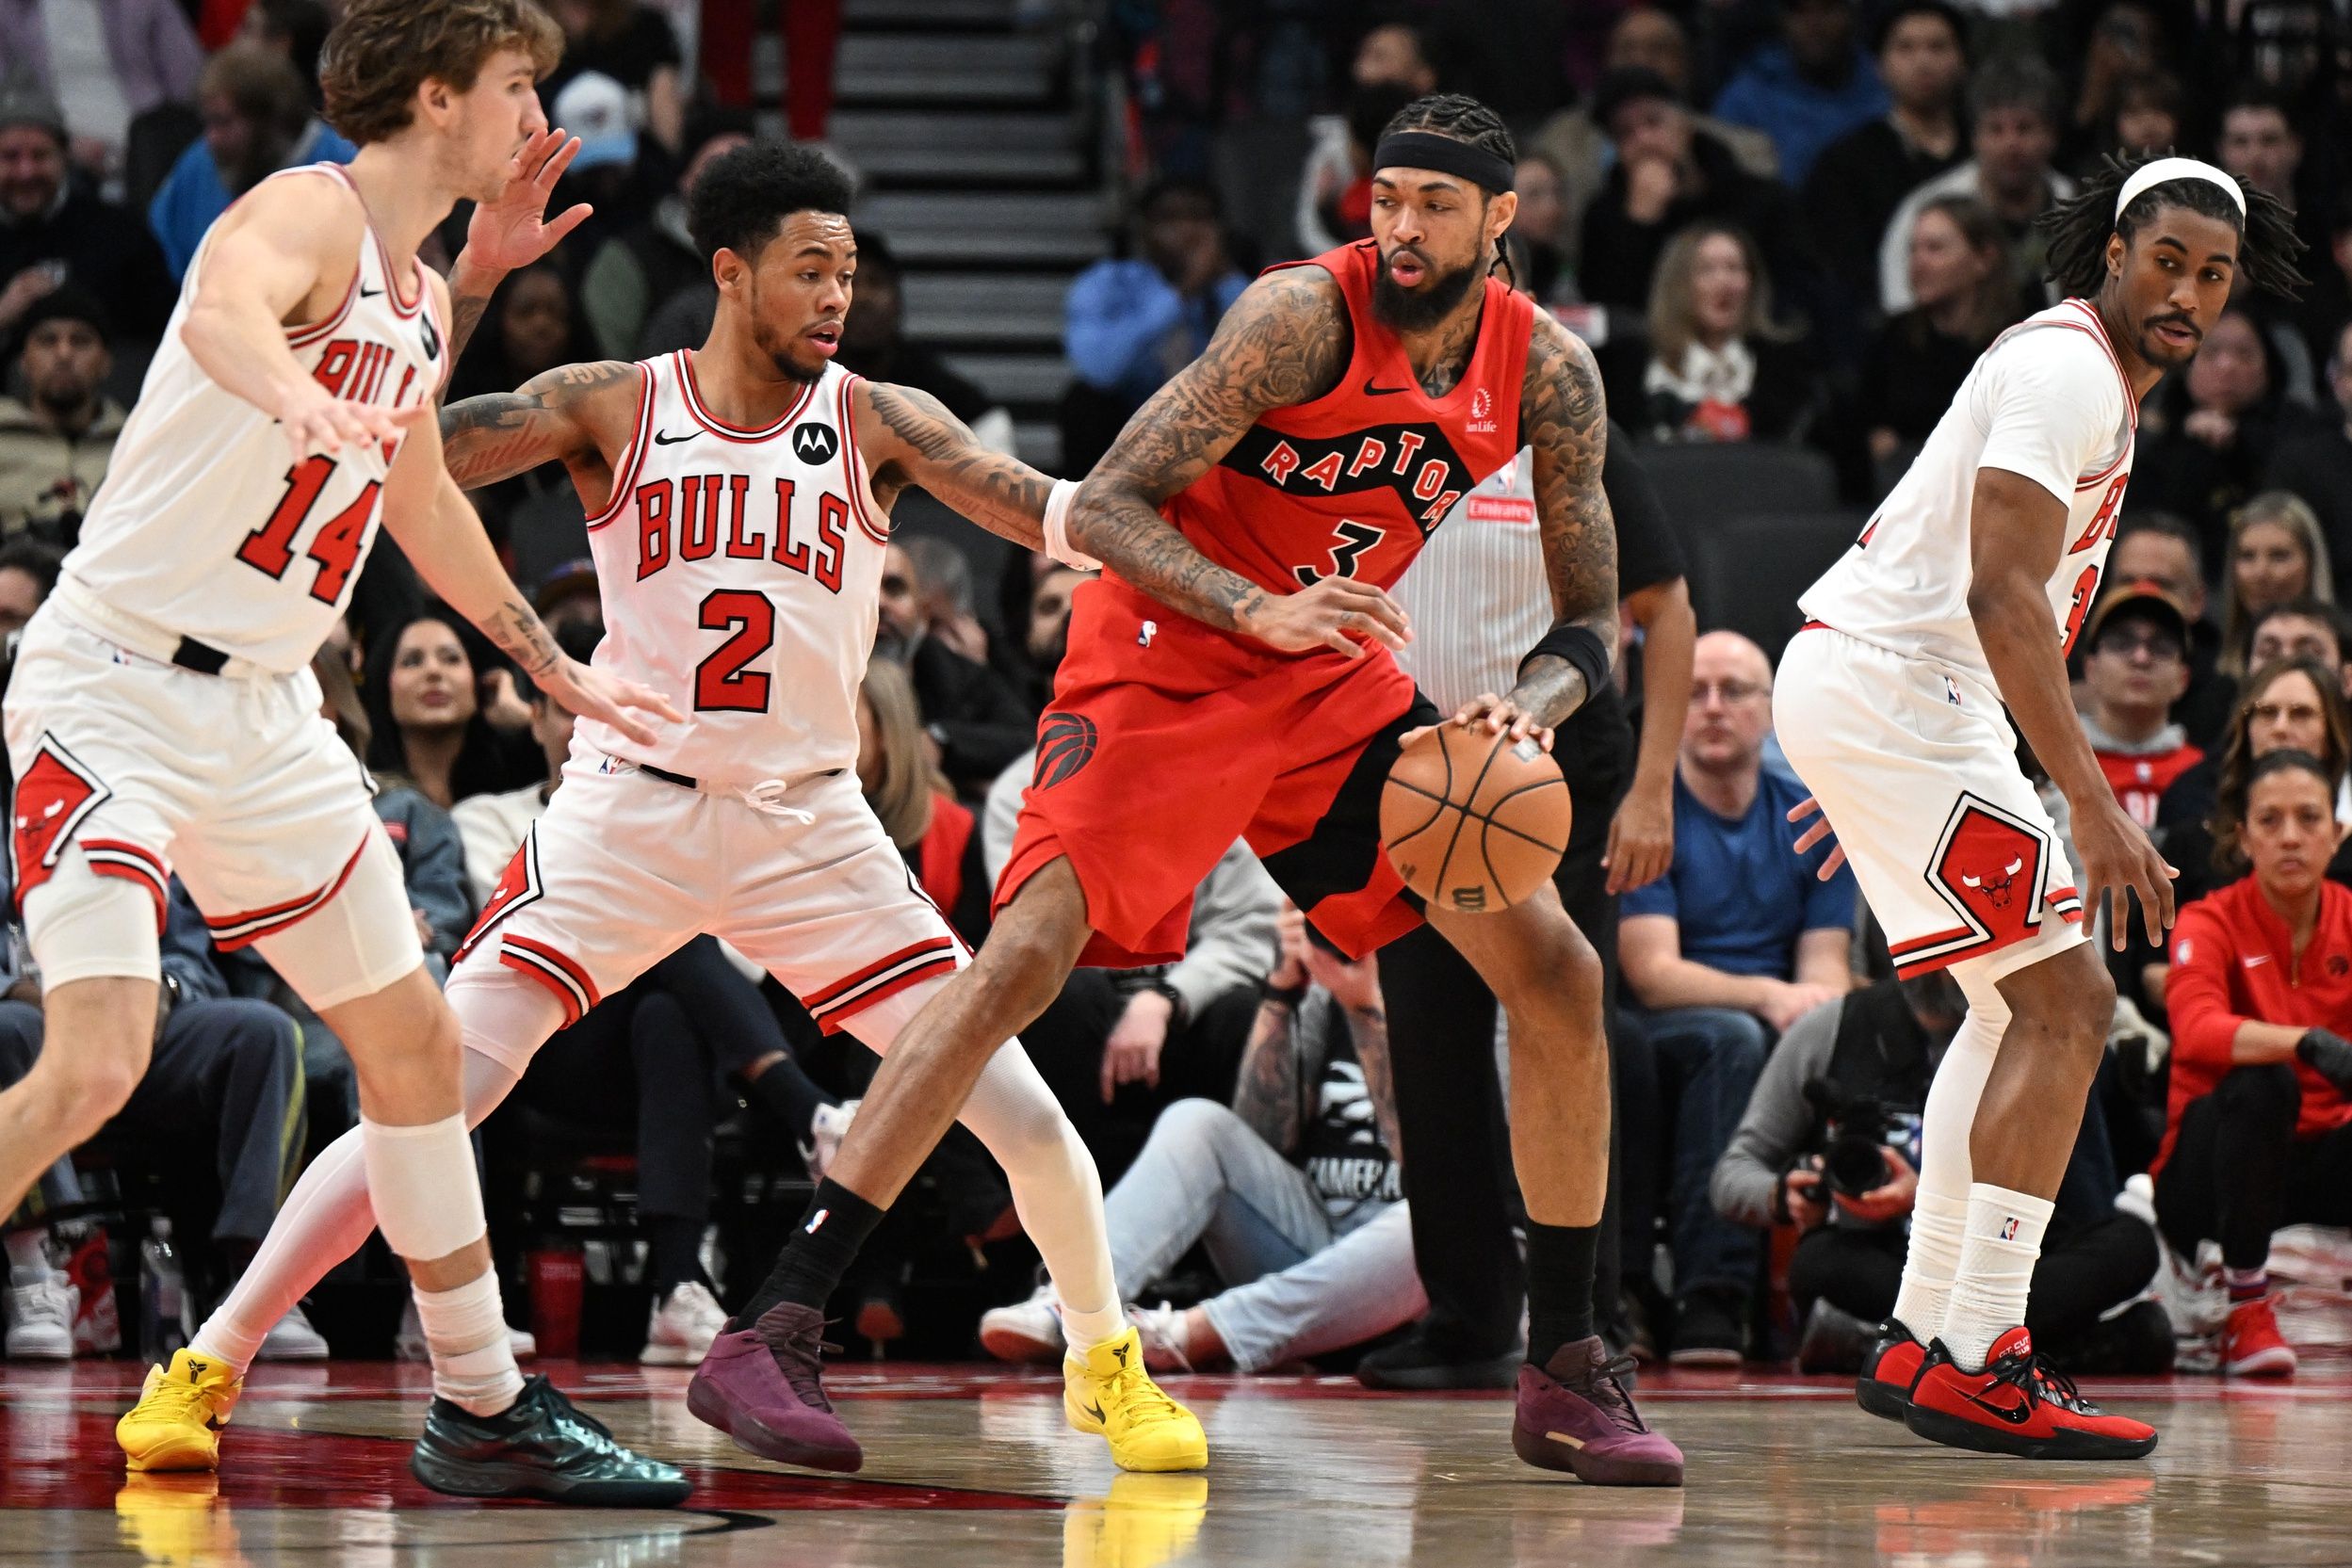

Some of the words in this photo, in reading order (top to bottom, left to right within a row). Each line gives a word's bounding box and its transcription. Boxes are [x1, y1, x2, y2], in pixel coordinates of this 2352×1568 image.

[234, 453, 382, 607] 14
[636, 474, 849, 595] BULLS
[1468, 499, 1533, 520] Emirates
[2068, 472, 2129, 556] B
[1292, 518, 1387, 589] 3
[693, 588, 776, 714] 2
[2014, 1335, 2030, 1350] CUT
